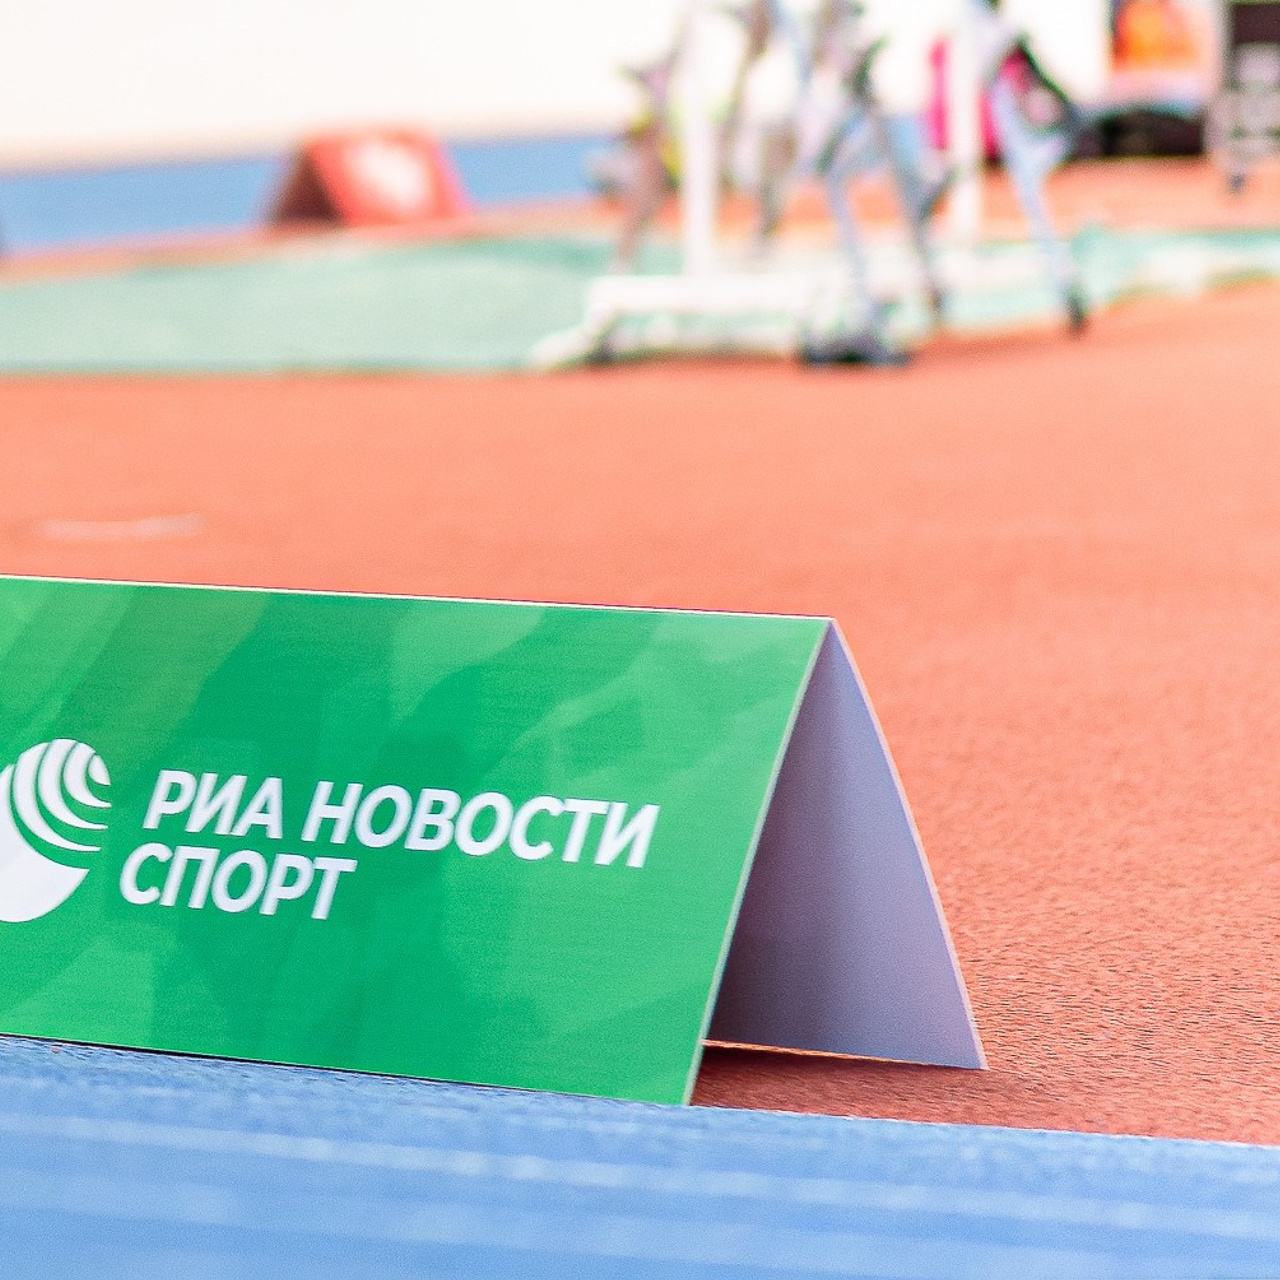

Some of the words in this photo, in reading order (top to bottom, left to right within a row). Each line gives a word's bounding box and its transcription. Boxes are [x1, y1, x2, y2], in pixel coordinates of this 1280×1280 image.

[142, 769, 283, 839] РИА
[301, 780, 660, 868] НОВОСТИ
[119, 842, 358, 920] СПОРТ
